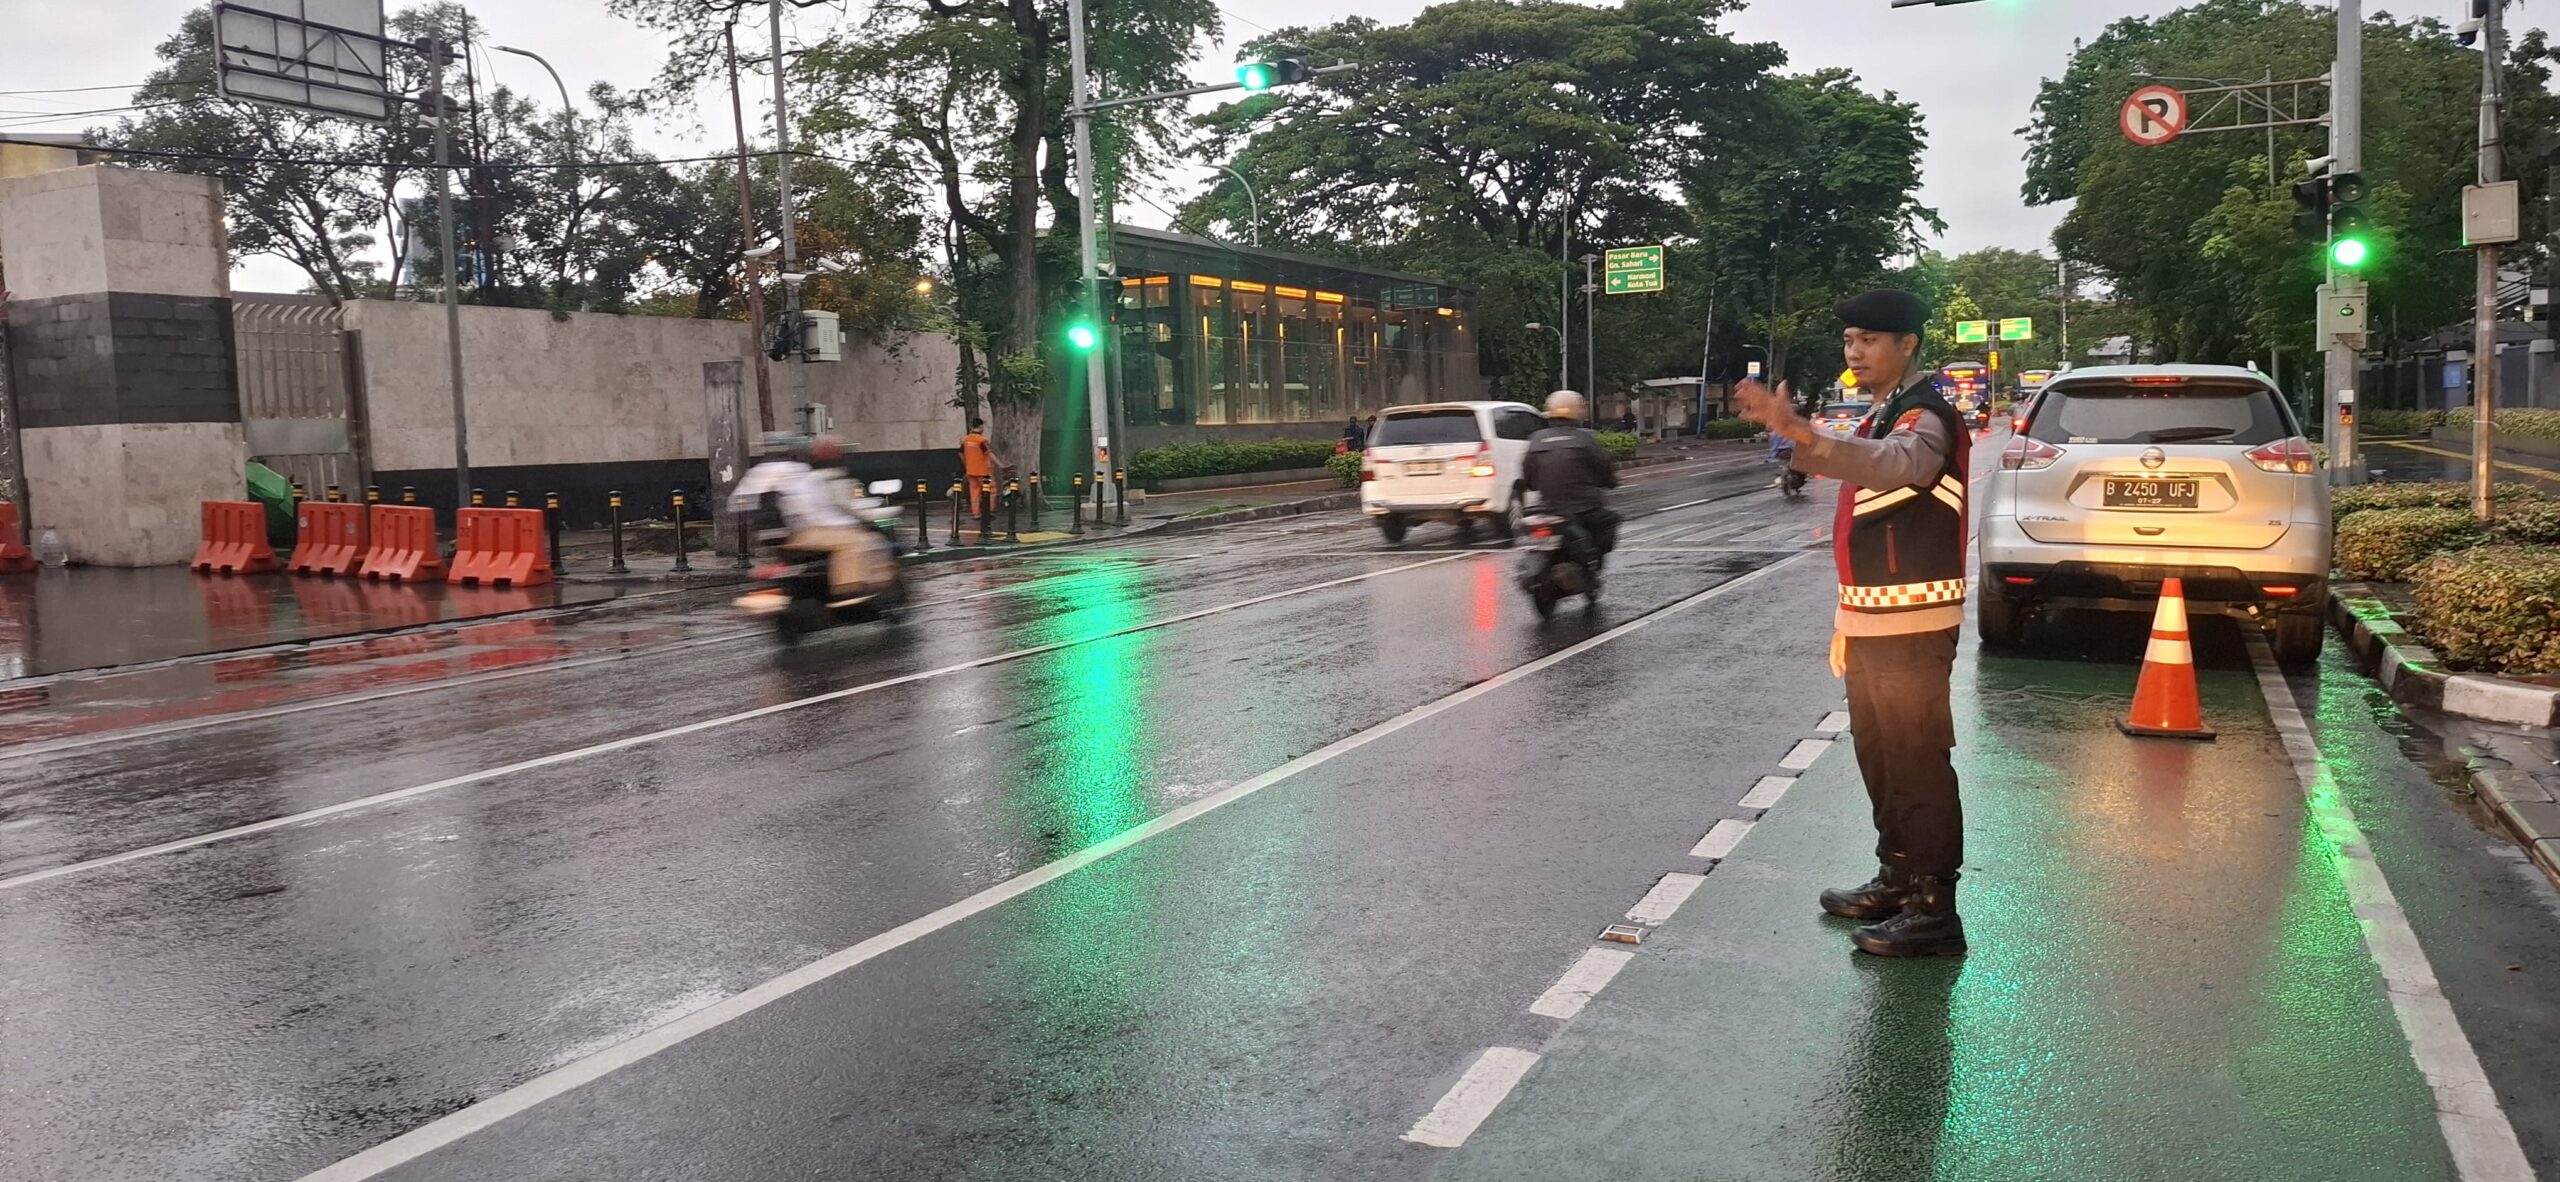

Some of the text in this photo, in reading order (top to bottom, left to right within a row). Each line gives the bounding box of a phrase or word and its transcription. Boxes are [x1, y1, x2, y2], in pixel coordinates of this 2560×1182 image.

[2141, 98, 2168, 133] P
[1621, 260, 1643, 268] Sahari
[2106, 482, 2195, 497] B 2450 UFJ
